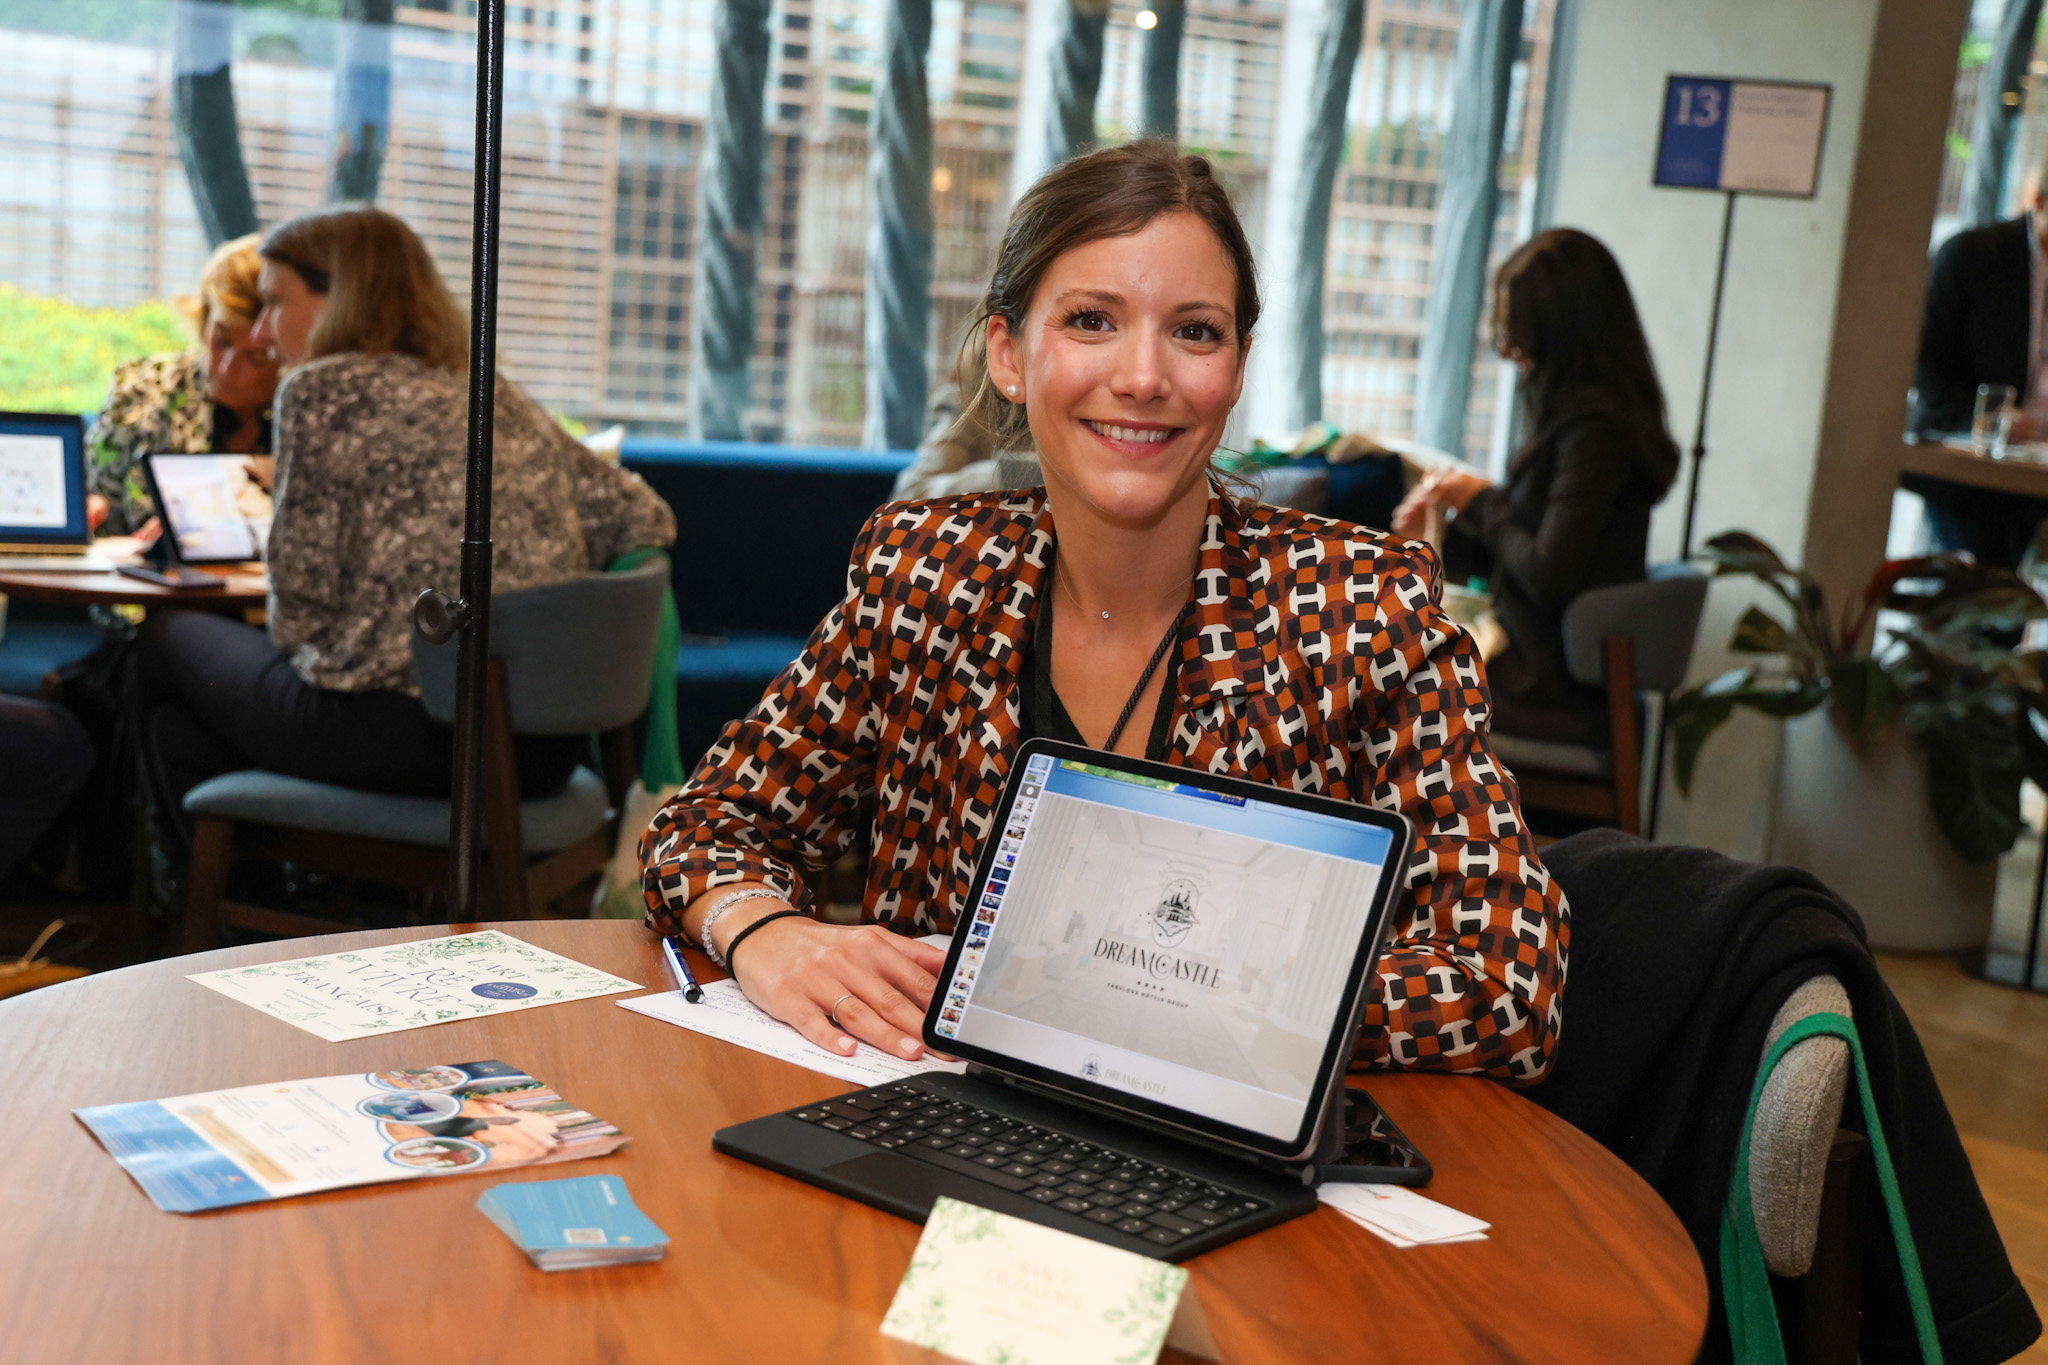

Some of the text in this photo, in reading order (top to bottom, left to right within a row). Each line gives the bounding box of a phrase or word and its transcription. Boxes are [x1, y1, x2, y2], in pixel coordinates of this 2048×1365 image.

[1674, 84, 1722, 128] 13
[347, 963, 463, 1007] VIVRE
[408, 967, 475, 987] RE
[467, 959, 531, 979] L'ART
[284, 971, 405, 1018] FRANÇAISE
[1106, 982, 1190, 1009] FABULOUS HOTELS GROUP
